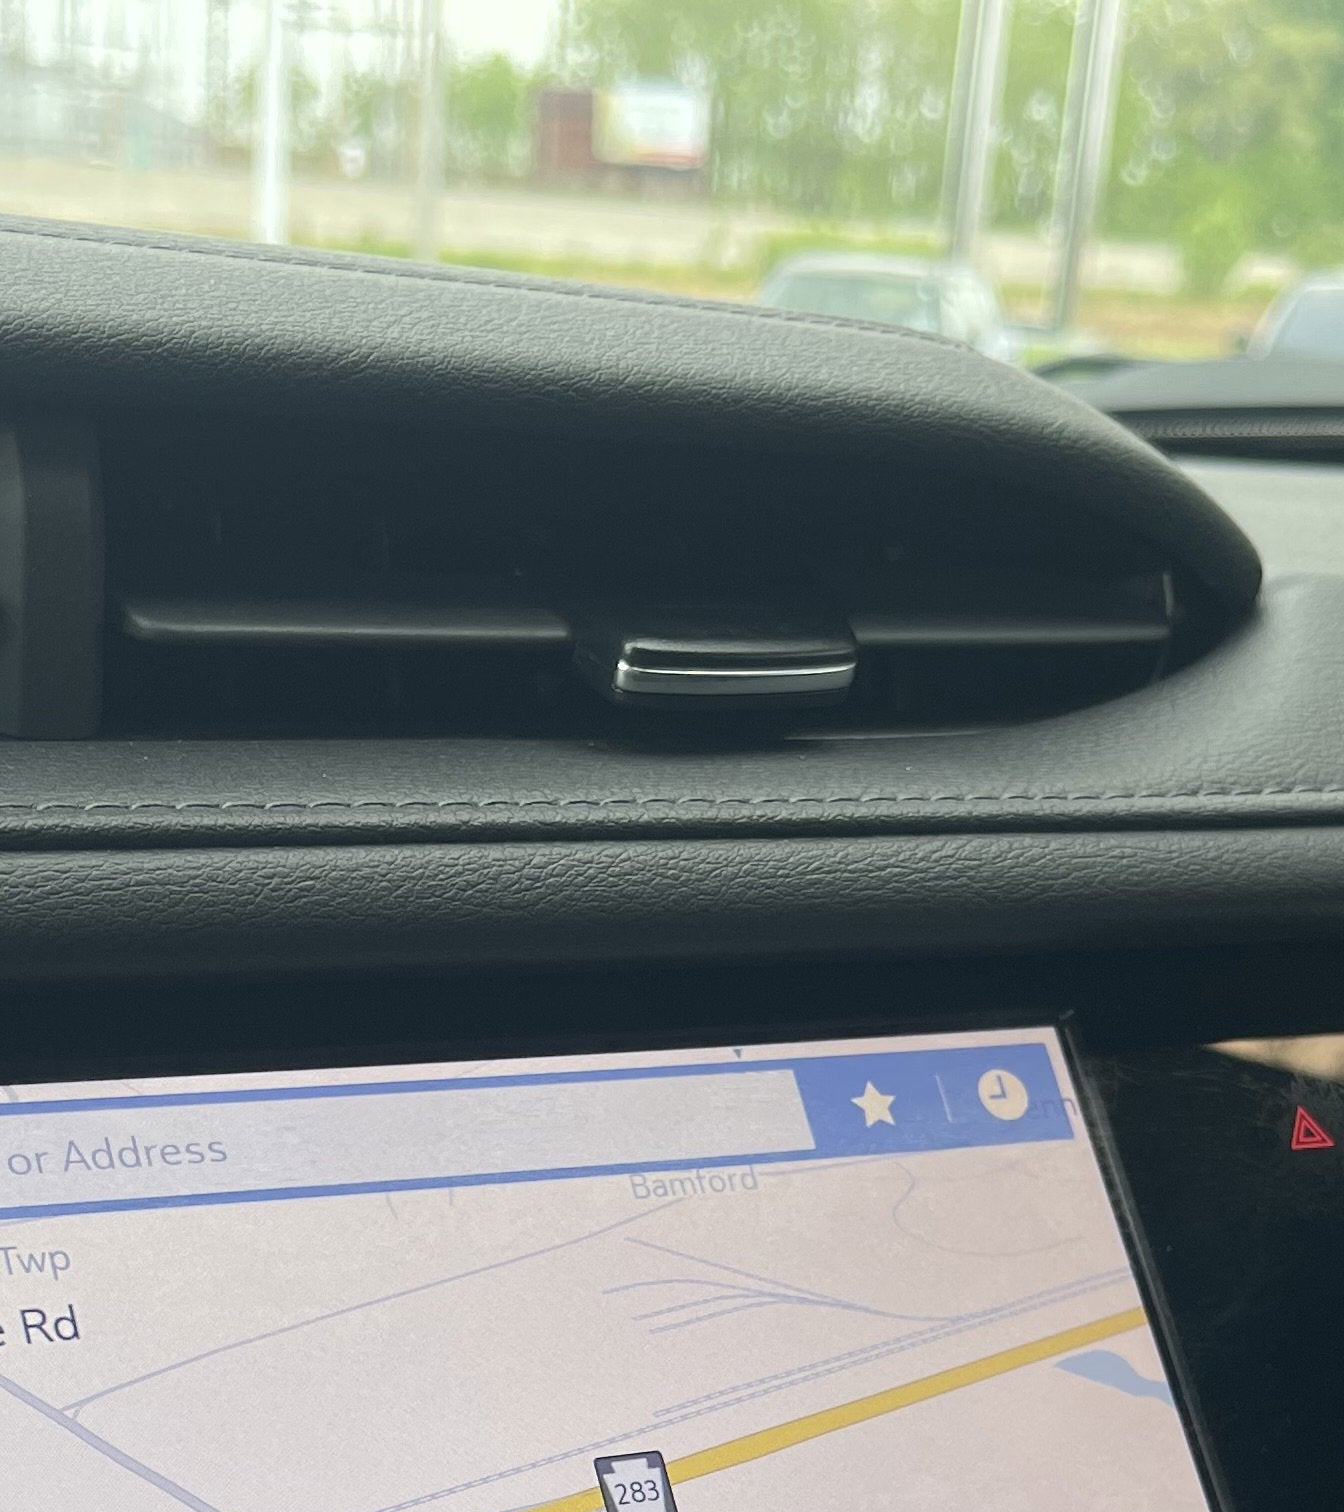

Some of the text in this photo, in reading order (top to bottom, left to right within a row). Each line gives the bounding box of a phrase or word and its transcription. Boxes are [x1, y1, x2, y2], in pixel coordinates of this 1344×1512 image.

[7, 1151, 49, 1176] or
[63, 1135, 229, 1173] Address
[629, 1164, 759, 1200] Bamford
[19, 1304, 82, 1345] Rd
[613, 1479, 661, 1506] 283
